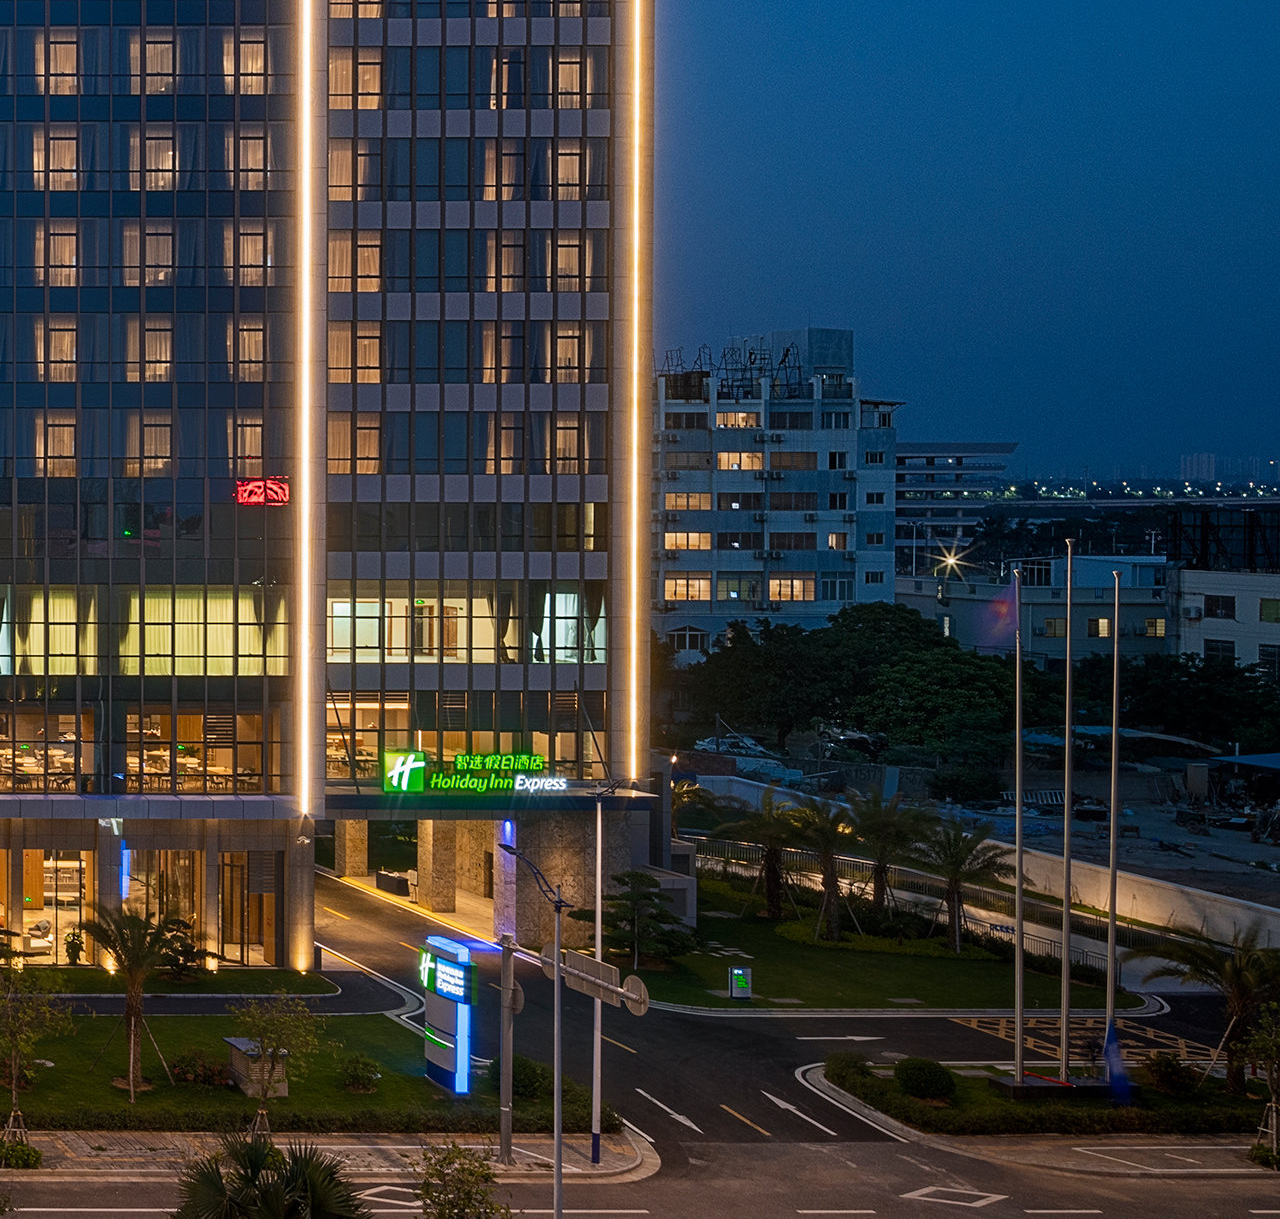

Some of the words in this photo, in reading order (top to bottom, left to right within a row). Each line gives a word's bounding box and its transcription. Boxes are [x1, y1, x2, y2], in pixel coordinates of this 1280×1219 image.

[455, 754, 545, 770] 智选假日酒店
[430, 773, 487, 792] Holiday
[489, 773, 513, 789] Inn
[514, 774, 567, 792] Express
[437, 978, 464, 996] Express
